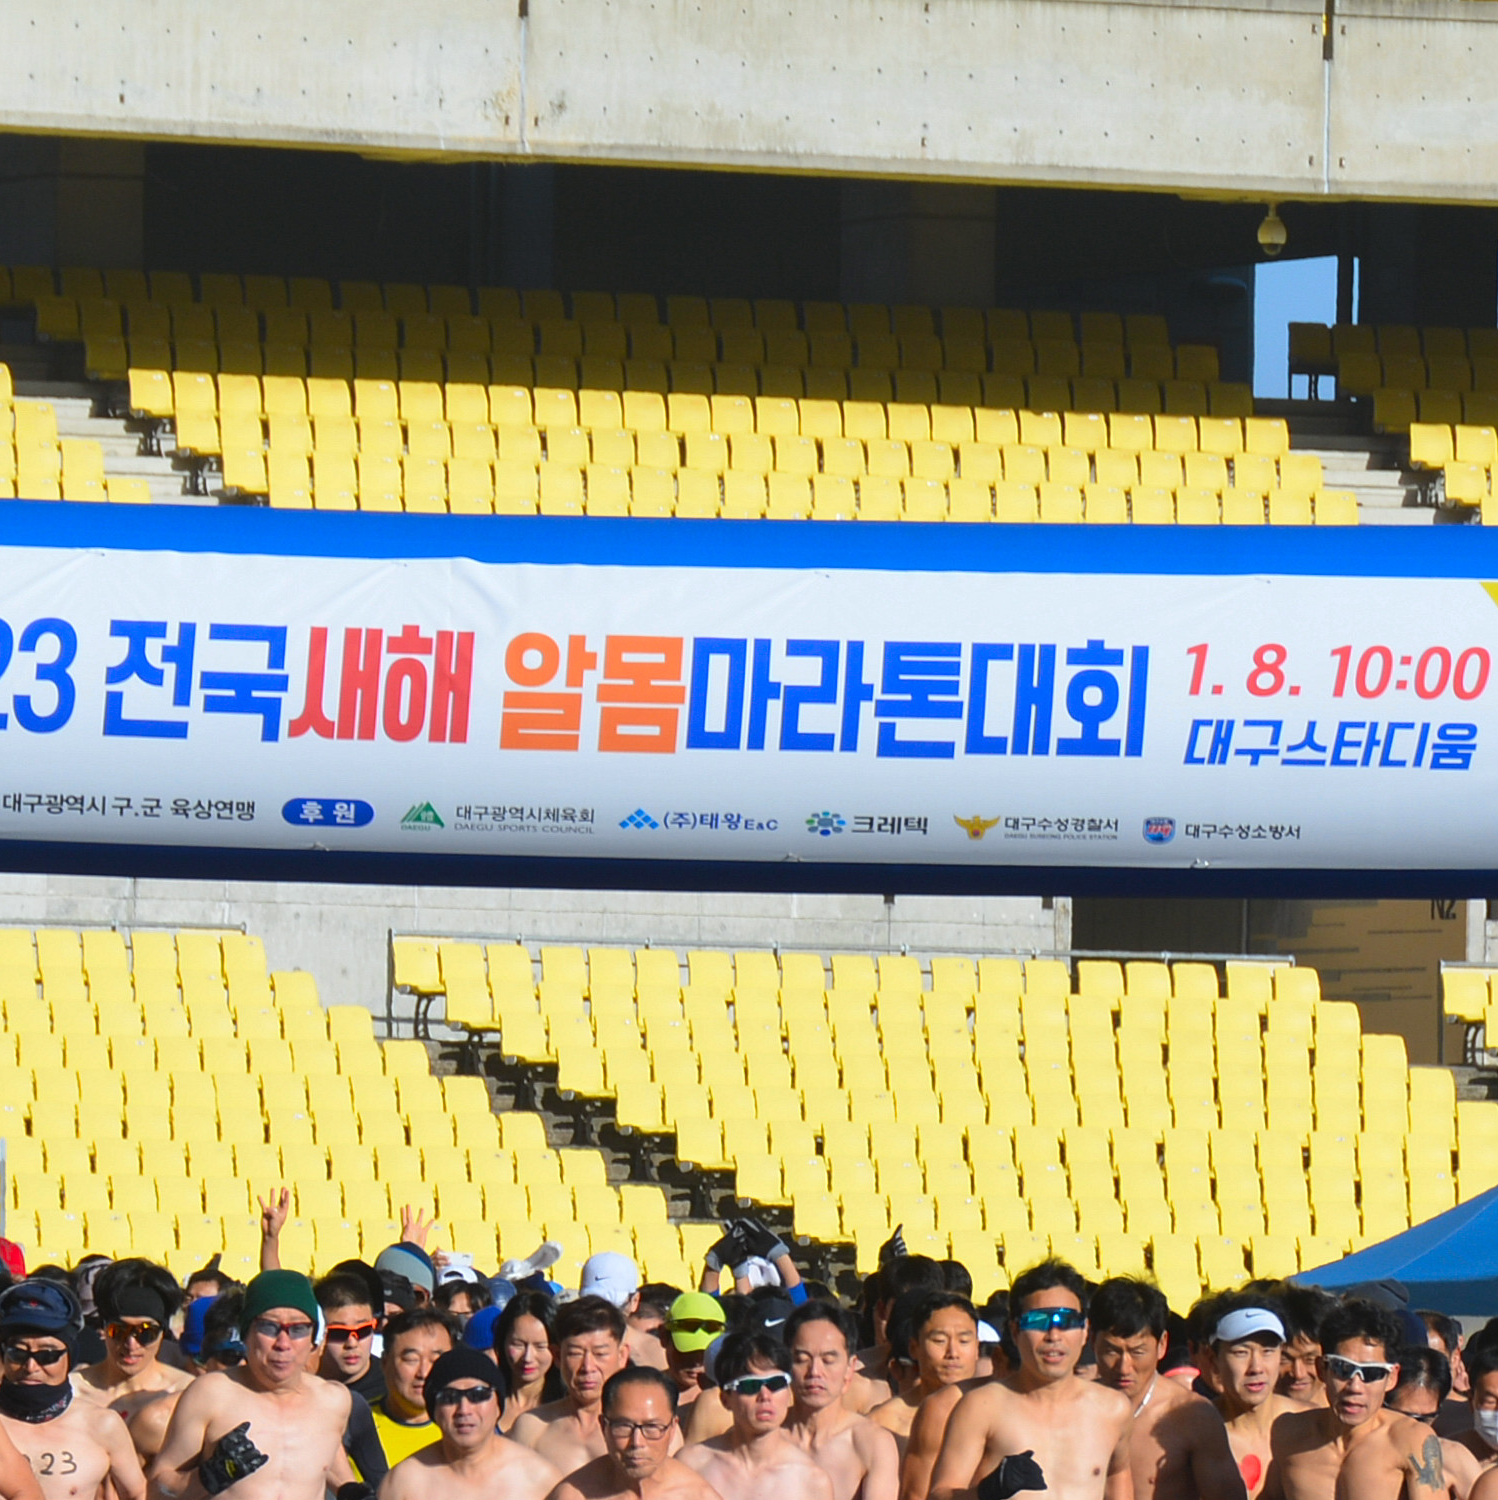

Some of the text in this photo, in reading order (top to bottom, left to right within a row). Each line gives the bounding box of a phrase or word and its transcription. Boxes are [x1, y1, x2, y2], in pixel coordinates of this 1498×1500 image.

[1330, 645, 1491, 701] 10:00
[1183, 718, 1479, 770] 대구스타디움
[2, 791, 106, 817] 대구광역시
[170, 798, 256, 821] 육상연맹
[455, 805, 595, 825] 대구광역시체육회
[454, 822, 594, 834] DAEGU SPORTS COUNCIL
[851, 811, 928, 836] 크레텍
[1004, 816, 1120, 835] 대구수성경찰서
[1184, 822, 1301, 841] 대구수성소방서
